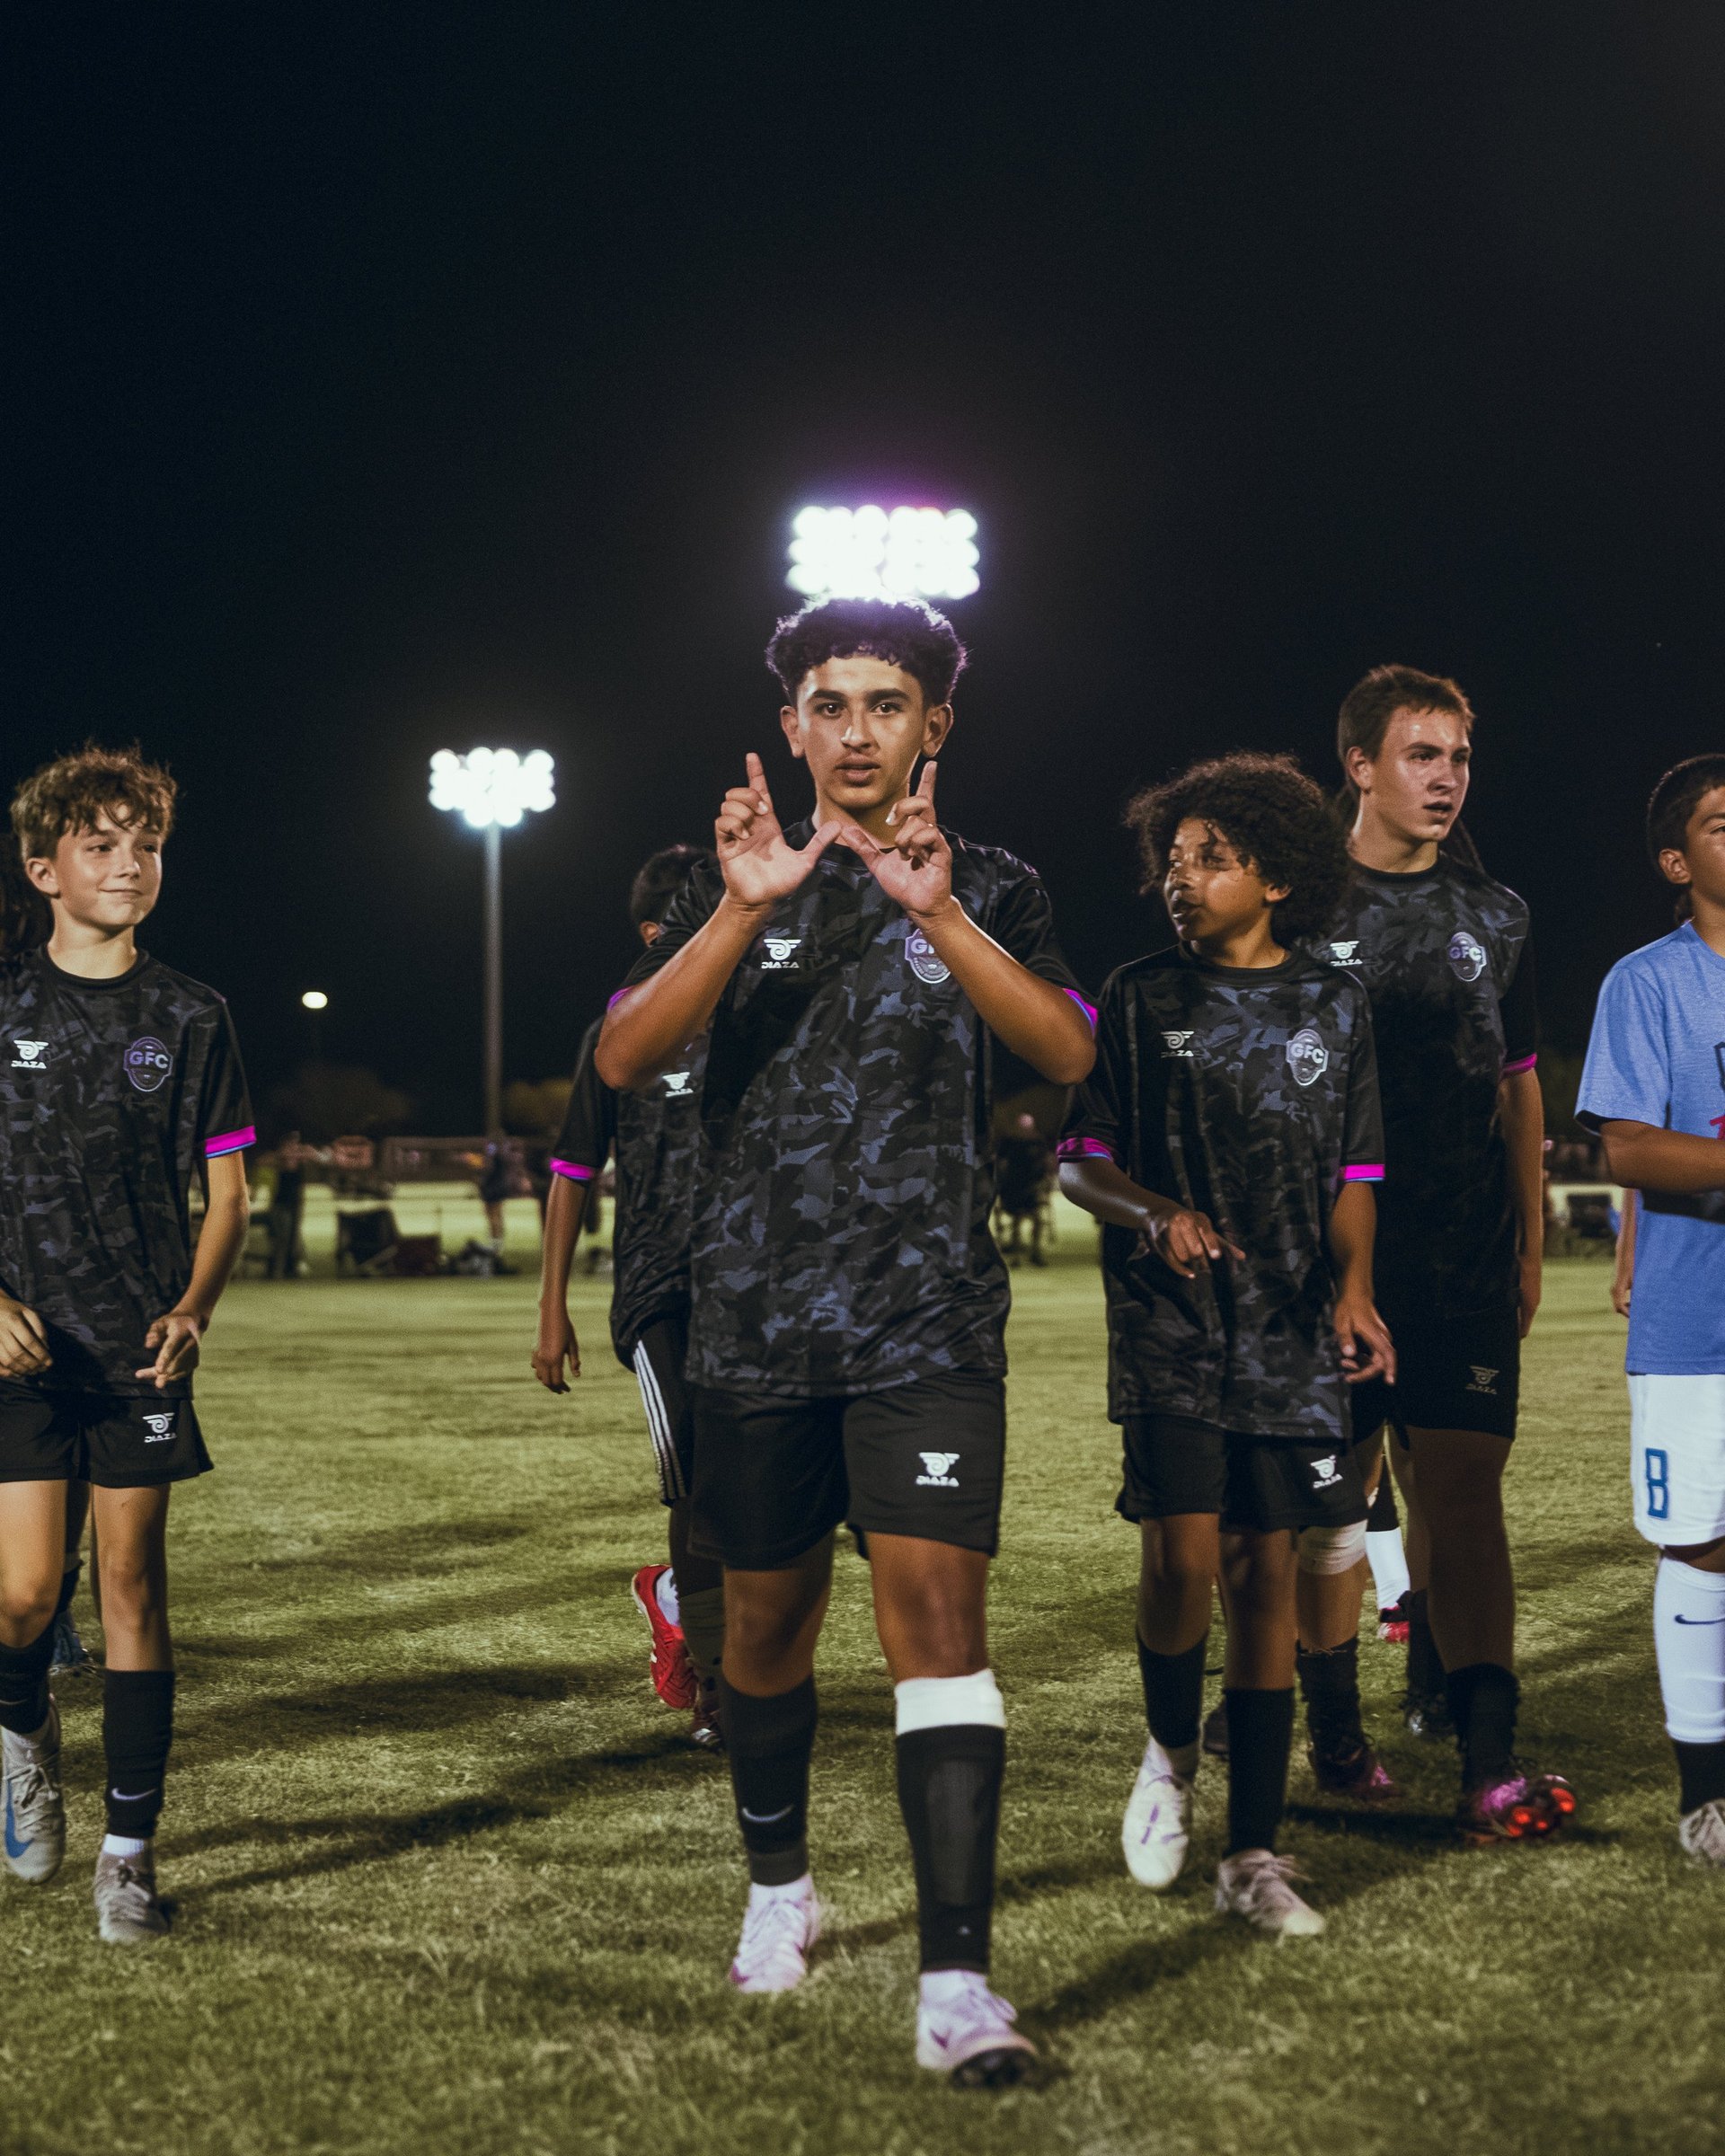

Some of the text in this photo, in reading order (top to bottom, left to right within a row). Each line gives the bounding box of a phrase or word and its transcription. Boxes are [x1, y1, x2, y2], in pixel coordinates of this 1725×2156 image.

[1449, 946, 1482, 961] GFC
[129, 1051, 168, 1069] GFC
[1290, 1043, 1324, 1064] GFC
